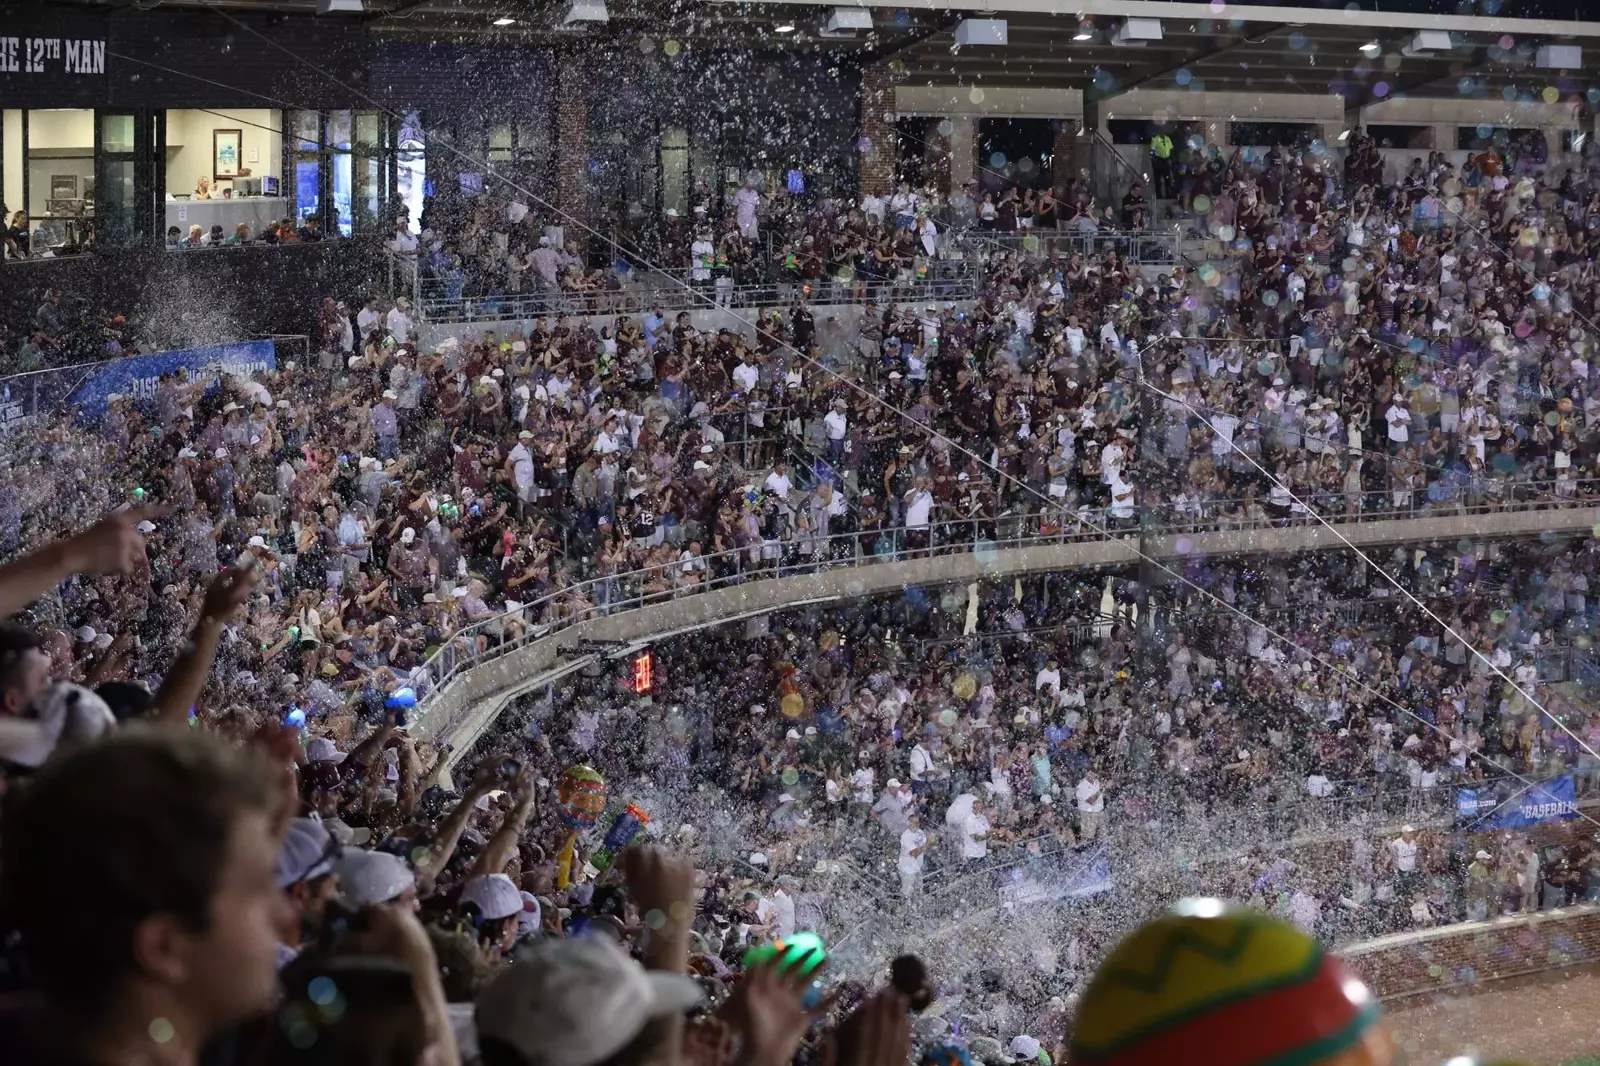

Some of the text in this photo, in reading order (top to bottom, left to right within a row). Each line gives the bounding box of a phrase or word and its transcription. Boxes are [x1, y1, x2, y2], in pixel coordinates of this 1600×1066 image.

[25, 38, 60, 72] 12TH
[65, 39, 105, 74] MAN
[641, 513, 653, 525] 12
[1525, 801, 1573, 819] BASEBALL
